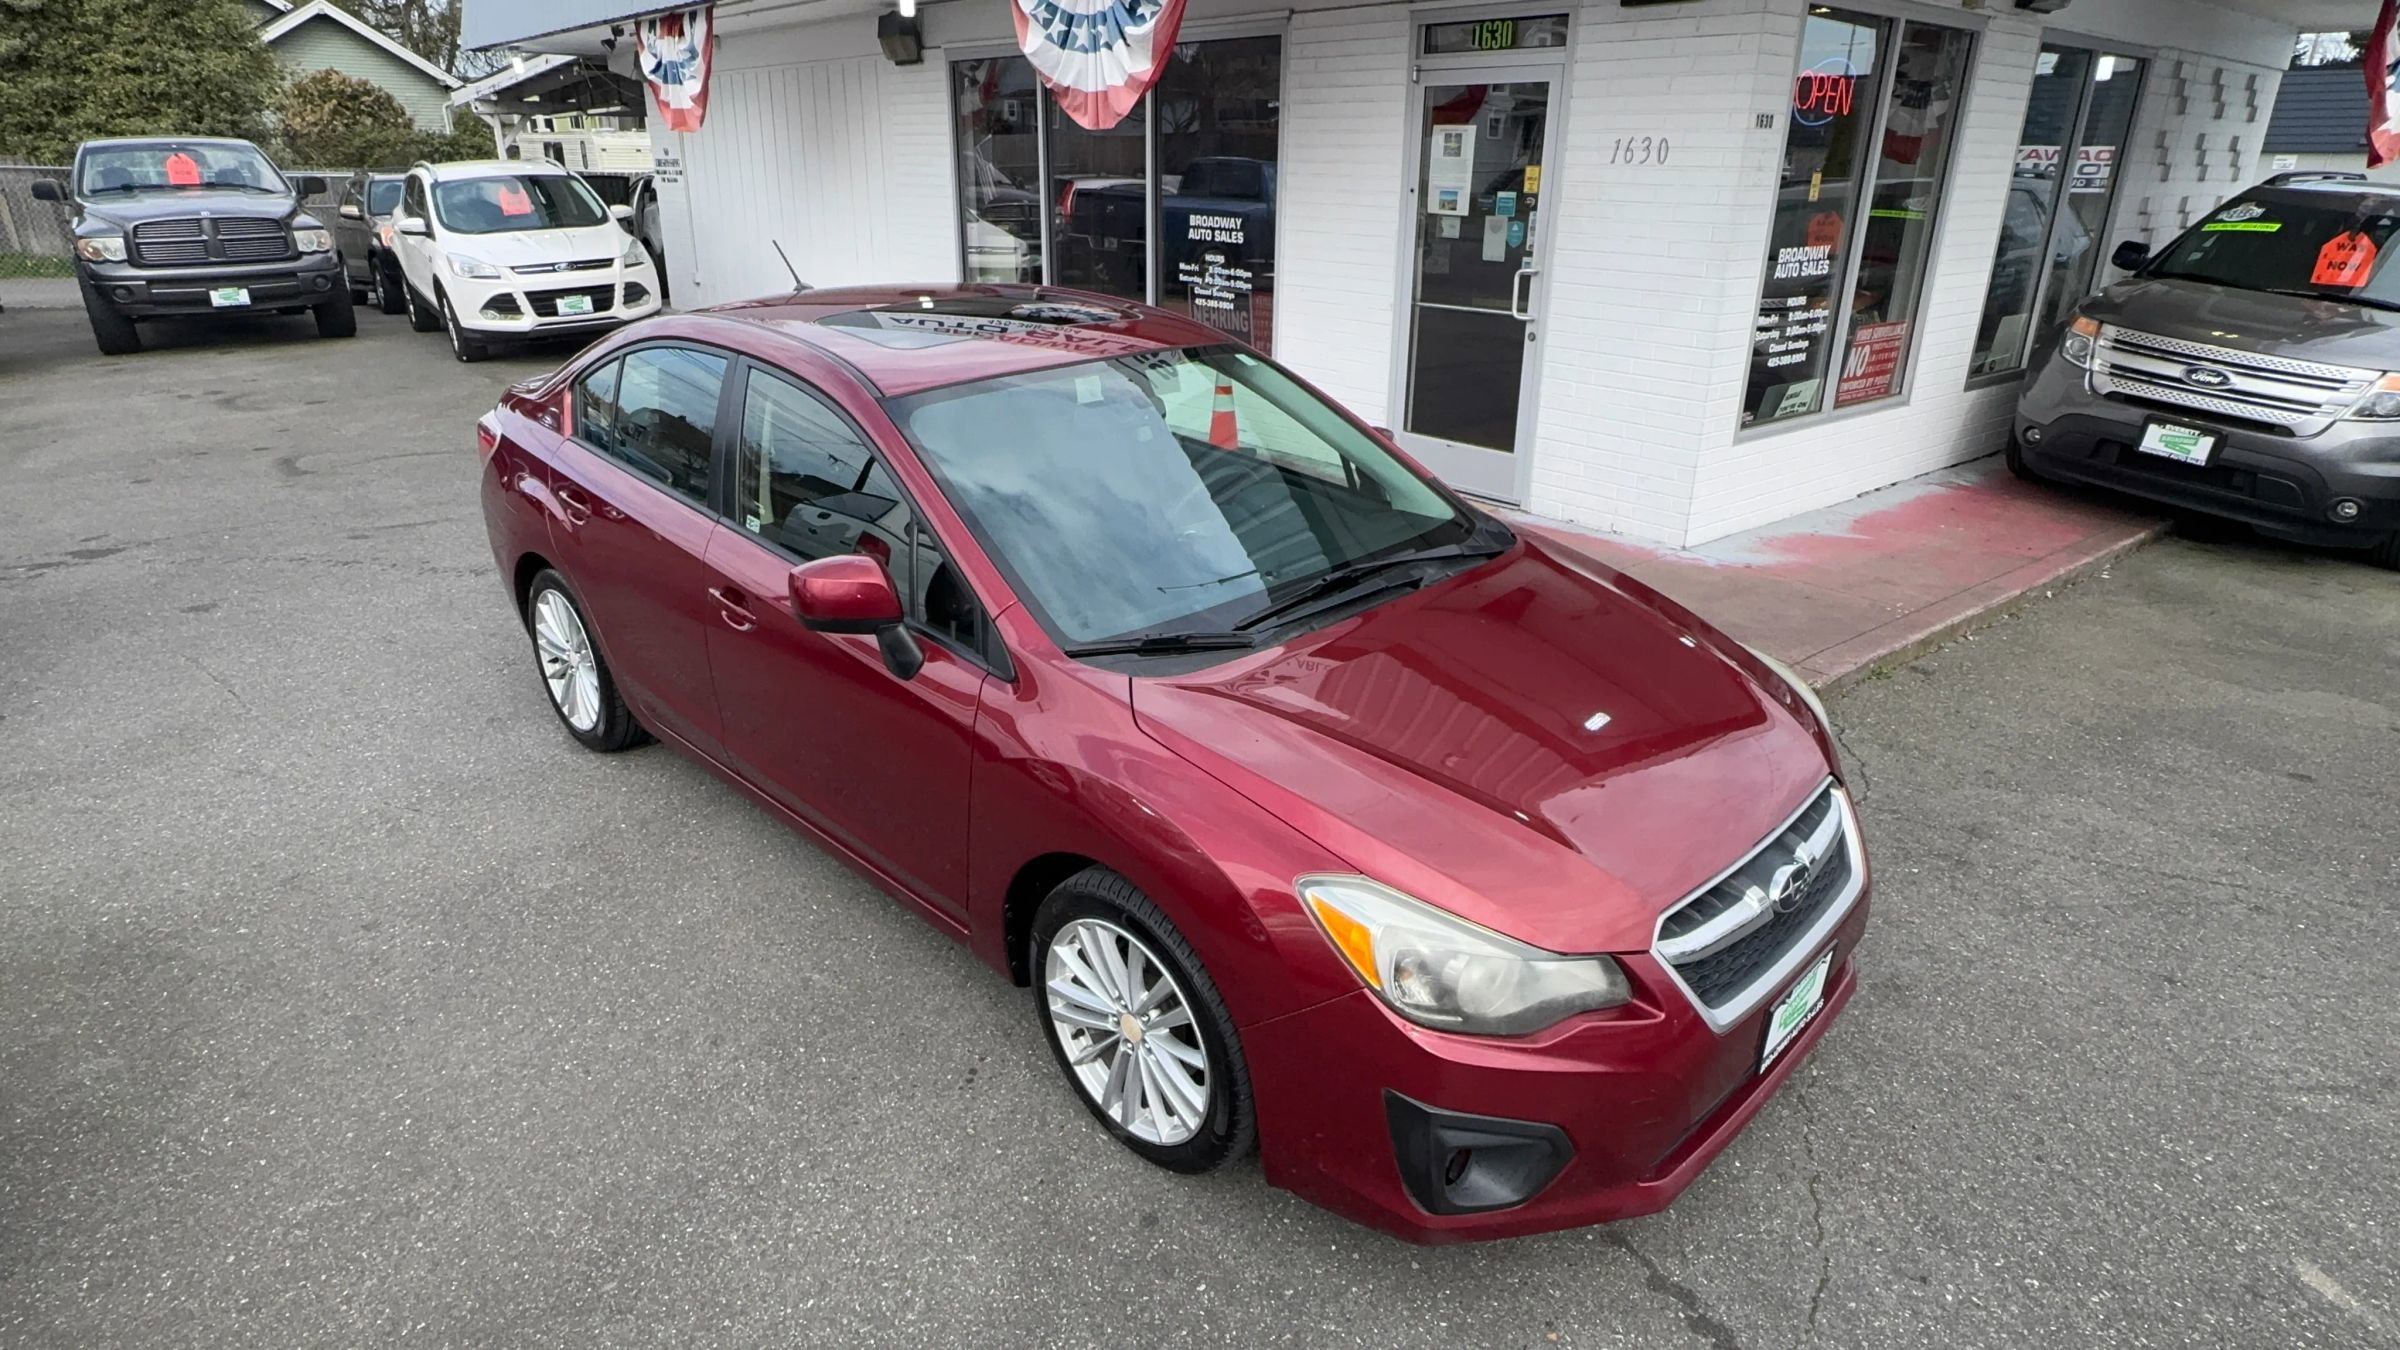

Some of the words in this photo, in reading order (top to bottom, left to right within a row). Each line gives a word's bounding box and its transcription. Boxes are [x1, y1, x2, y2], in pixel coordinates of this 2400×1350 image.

[1472, 20, 1512, 48] 1630
[1795, 70, 1854, 115] OPEN
[1756, 114, 1774, 128] 1630
[1610, 136, 1669, 165] 1630
[1190, 214, 1242, 230] BROADWAY
[1188, 228, 1212, 240] AUTO
[1214, 230, 1244, 244] SALES
[1205, 254, 1224, 262] HOURS
[1778, 245, 1831, 263] BROADWAY
[1774, 262, 1800, 279] AUTO
[1801, 260, 1829, 276] SALES
[1179, 274, 1202, 284] Saturday
[1787, 296, 1807, 306] HOURS
[1756, 330, 1780, 341] Saturday
[1844, 344, 1871, 378] NO
